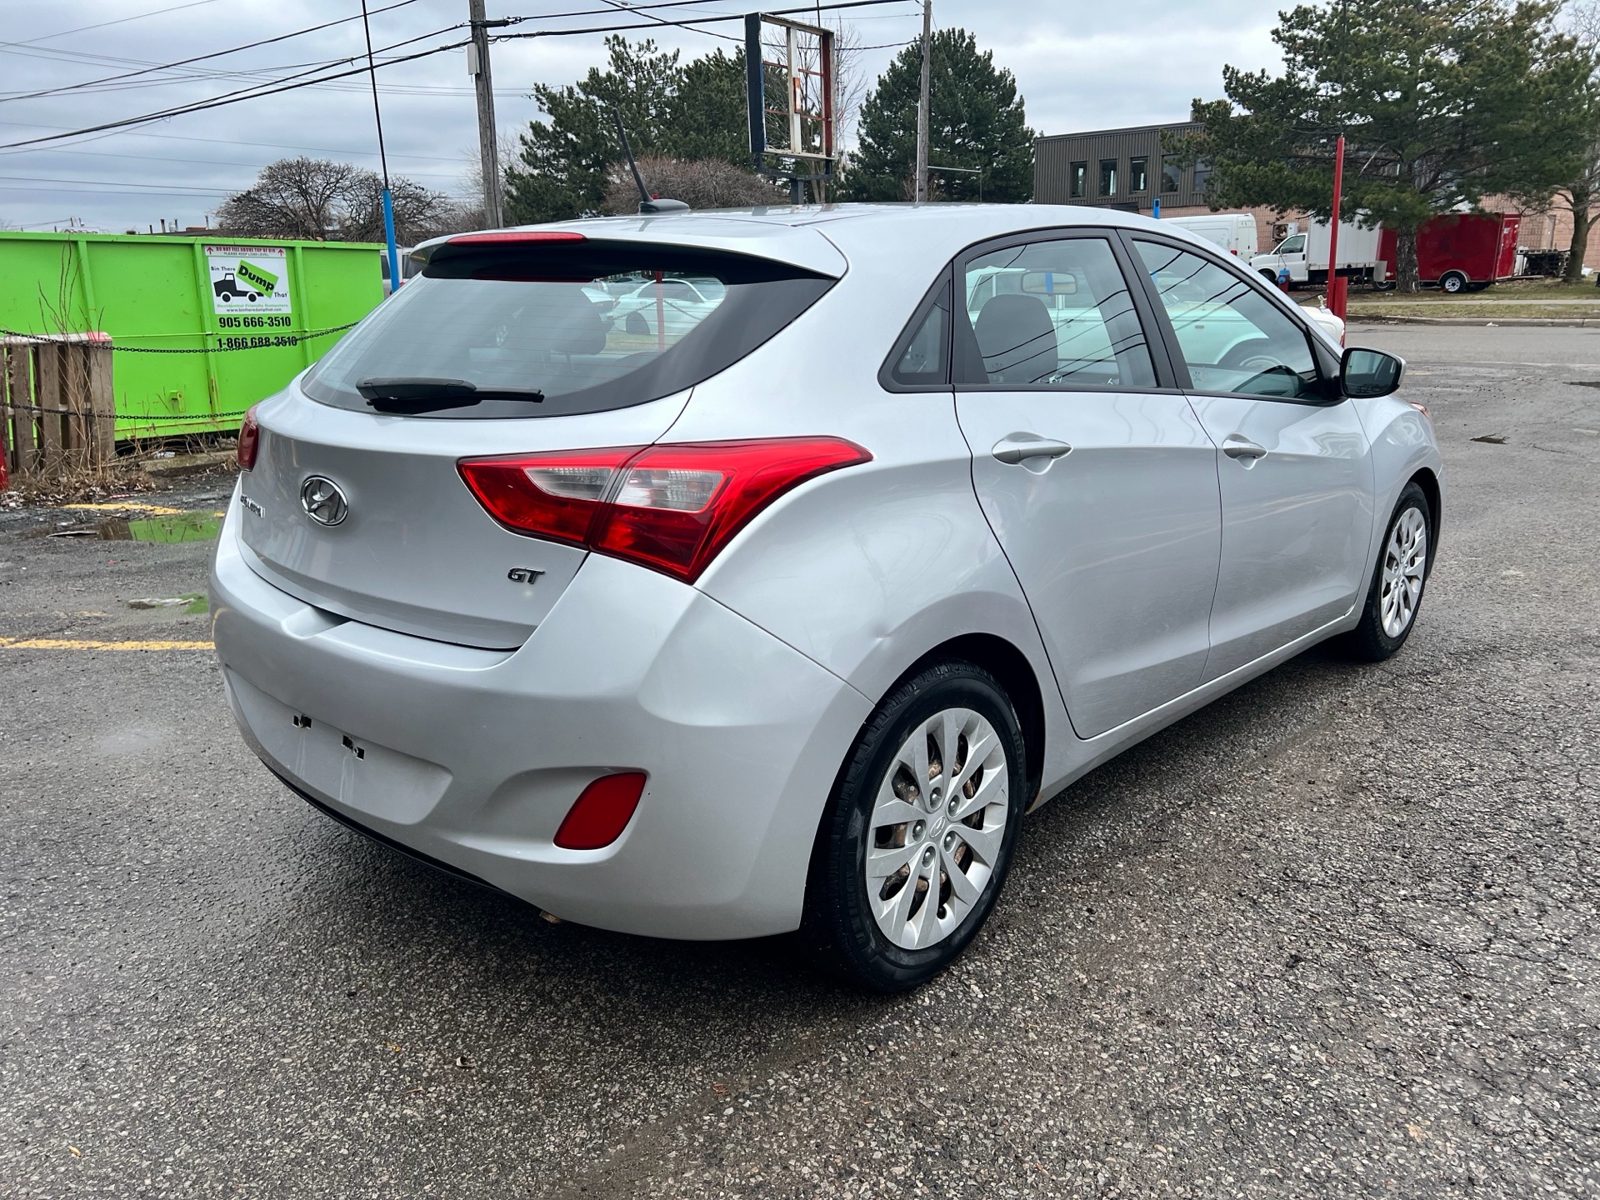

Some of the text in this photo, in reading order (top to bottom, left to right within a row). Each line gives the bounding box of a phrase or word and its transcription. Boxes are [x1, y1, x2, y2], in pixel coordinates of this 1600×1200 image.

[238, 264, 275, 292] Dump
[219, 316, 291, 328] 905 666-3510
[217, 336, 298, 349] 1-866 688-3510
[507, 567, 546, 585] GT
